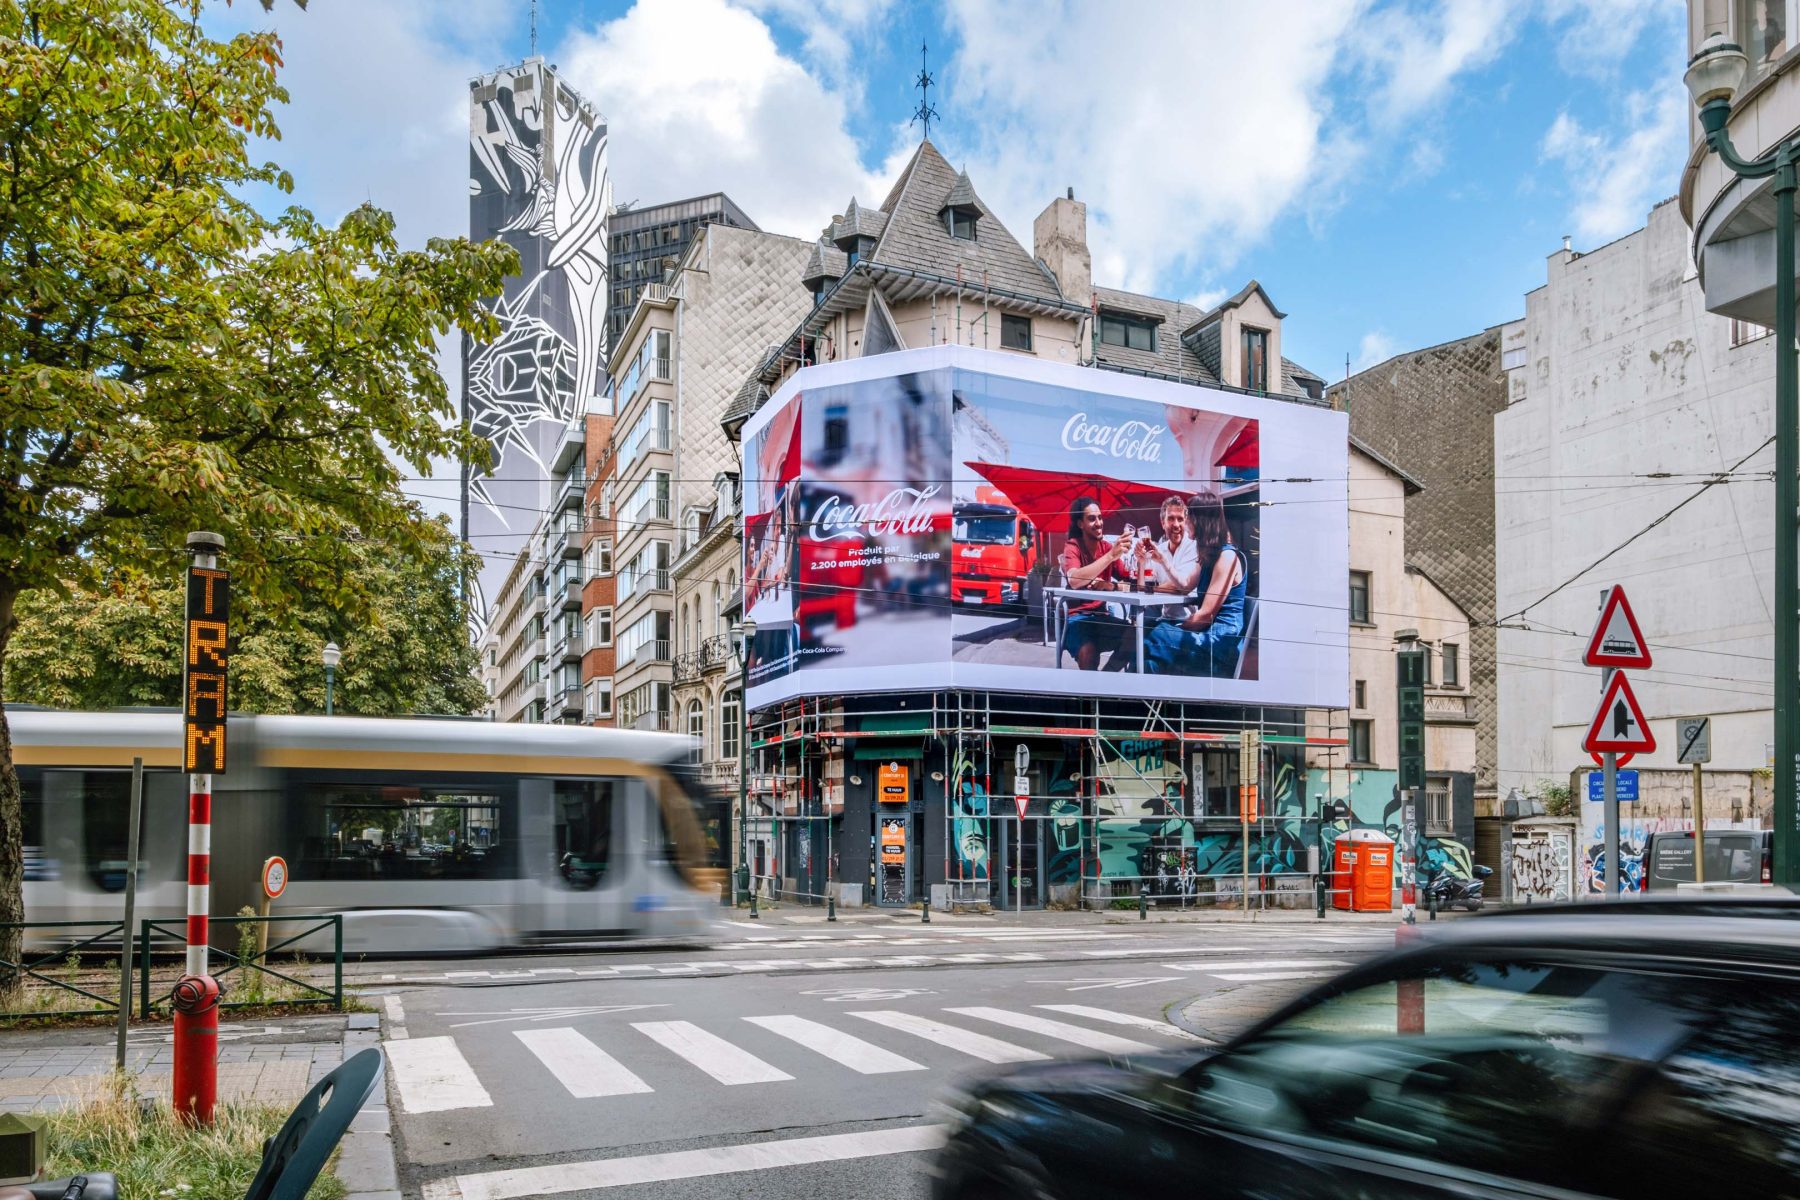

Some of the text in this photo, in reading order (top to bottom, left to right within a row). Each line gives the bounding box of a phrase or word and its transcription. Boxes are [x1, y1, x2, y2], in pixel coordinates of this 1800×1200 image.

[1061, 412, 1167, 463] Coca-Cola
[809, 484, 942, 542] Coca-Cola
[811, 551, 940, 570] 2.200 employés en Belgique
[848, 545, 899, 556] Produit par
[187, 568, 227, 769] TRAM
[1135, 750, 1164, 775] LAB
